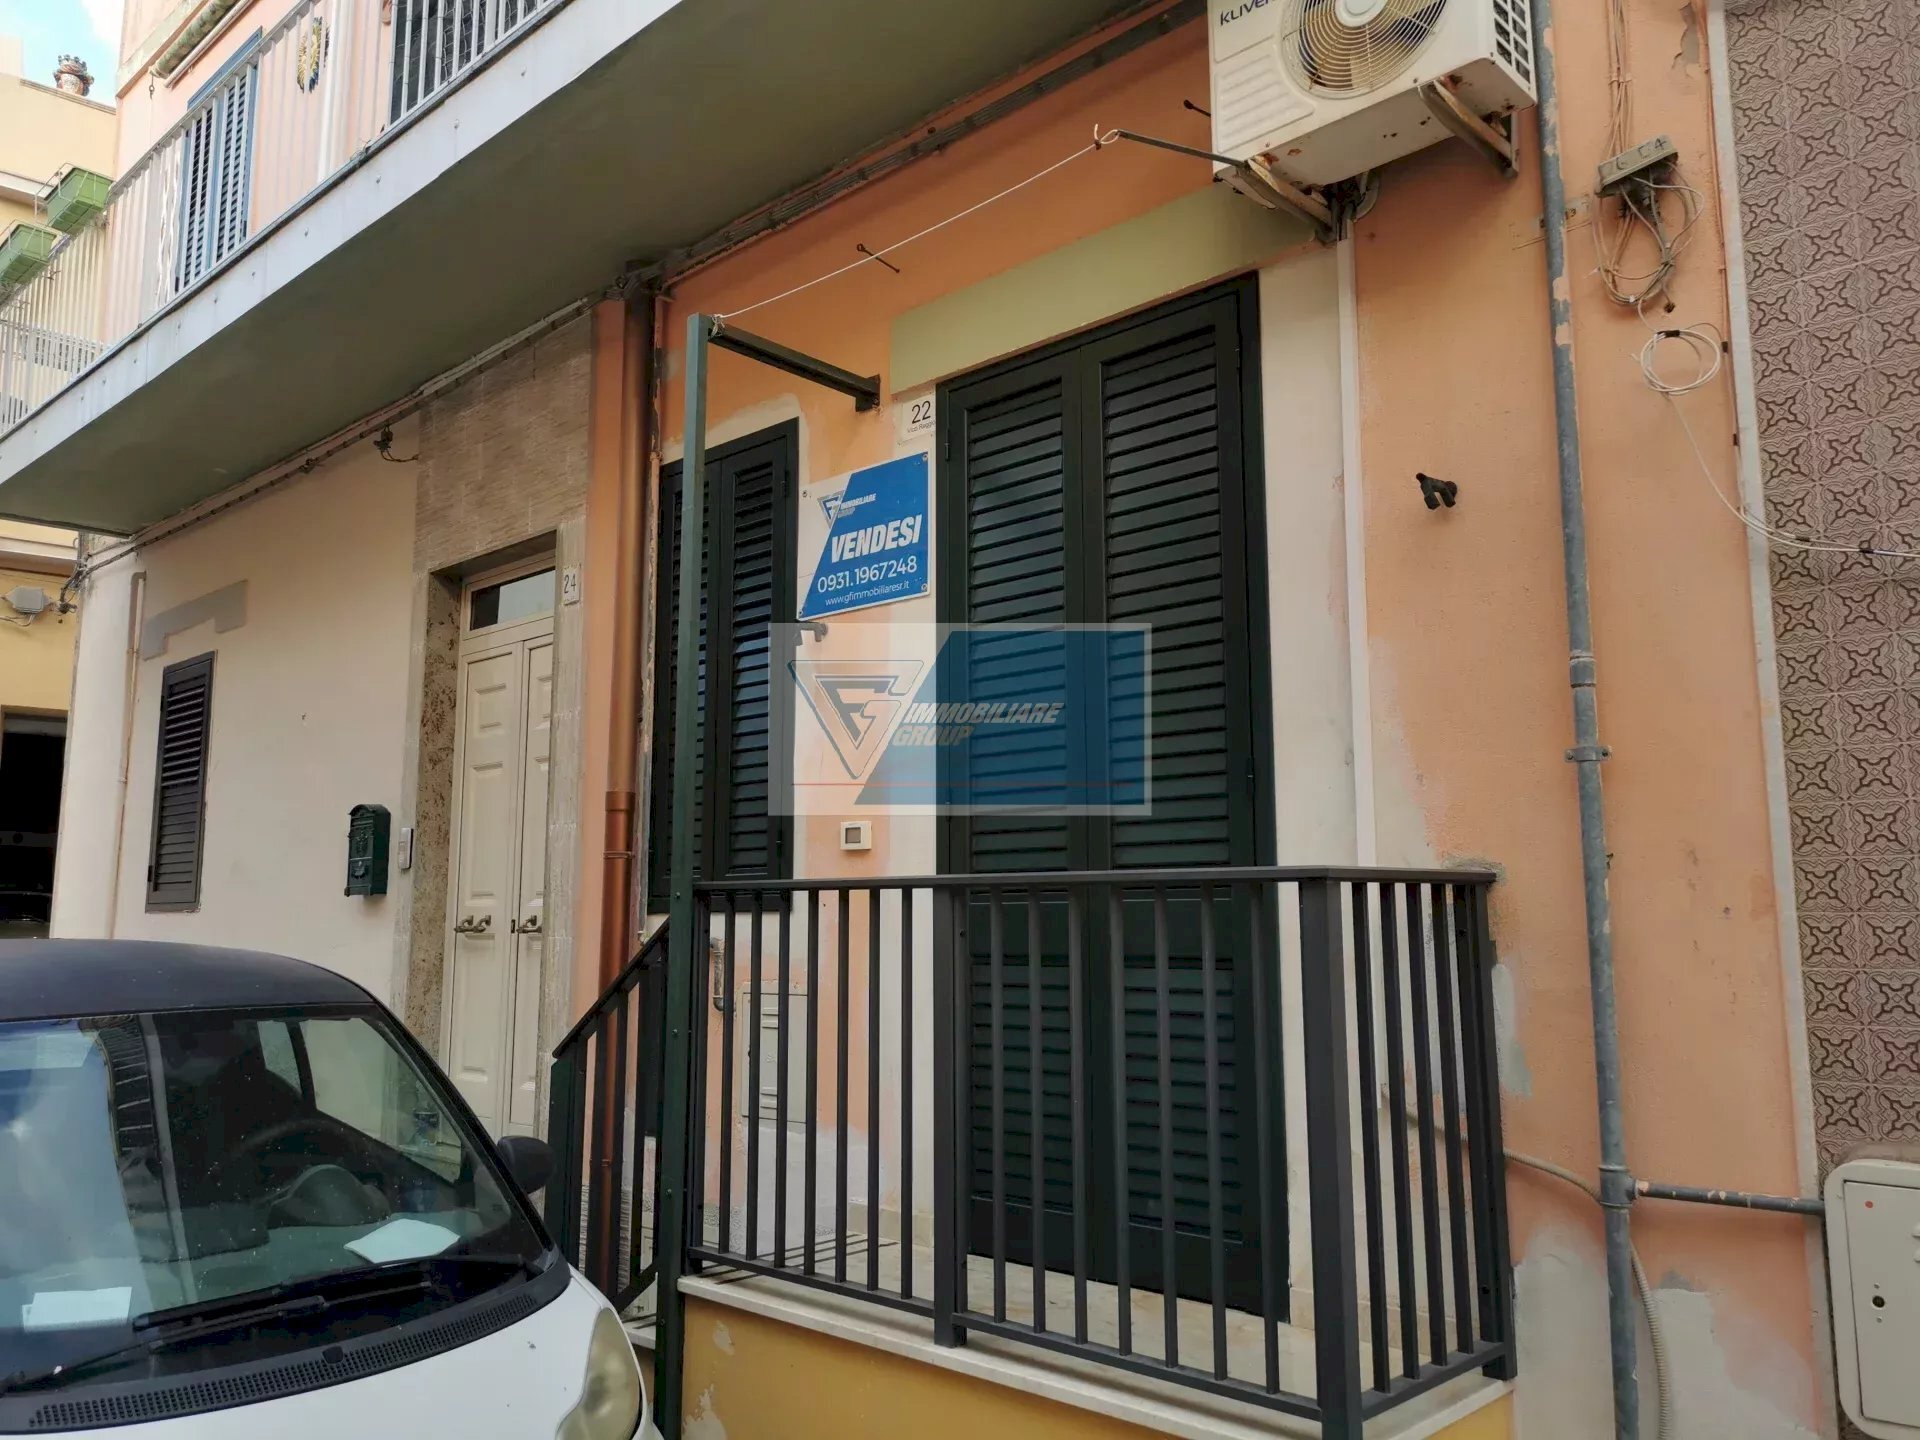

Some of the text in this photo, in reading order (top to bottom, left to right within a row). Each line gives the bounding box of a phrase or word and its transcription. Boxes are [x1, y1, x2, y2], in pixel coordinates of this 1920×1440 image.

[911, 400, 931, 424] 22
[831, 514, 923, 564] VENDESI
[564, 574, 576, 593] 24
[817, 555, 918, 593] 0931.1967248
